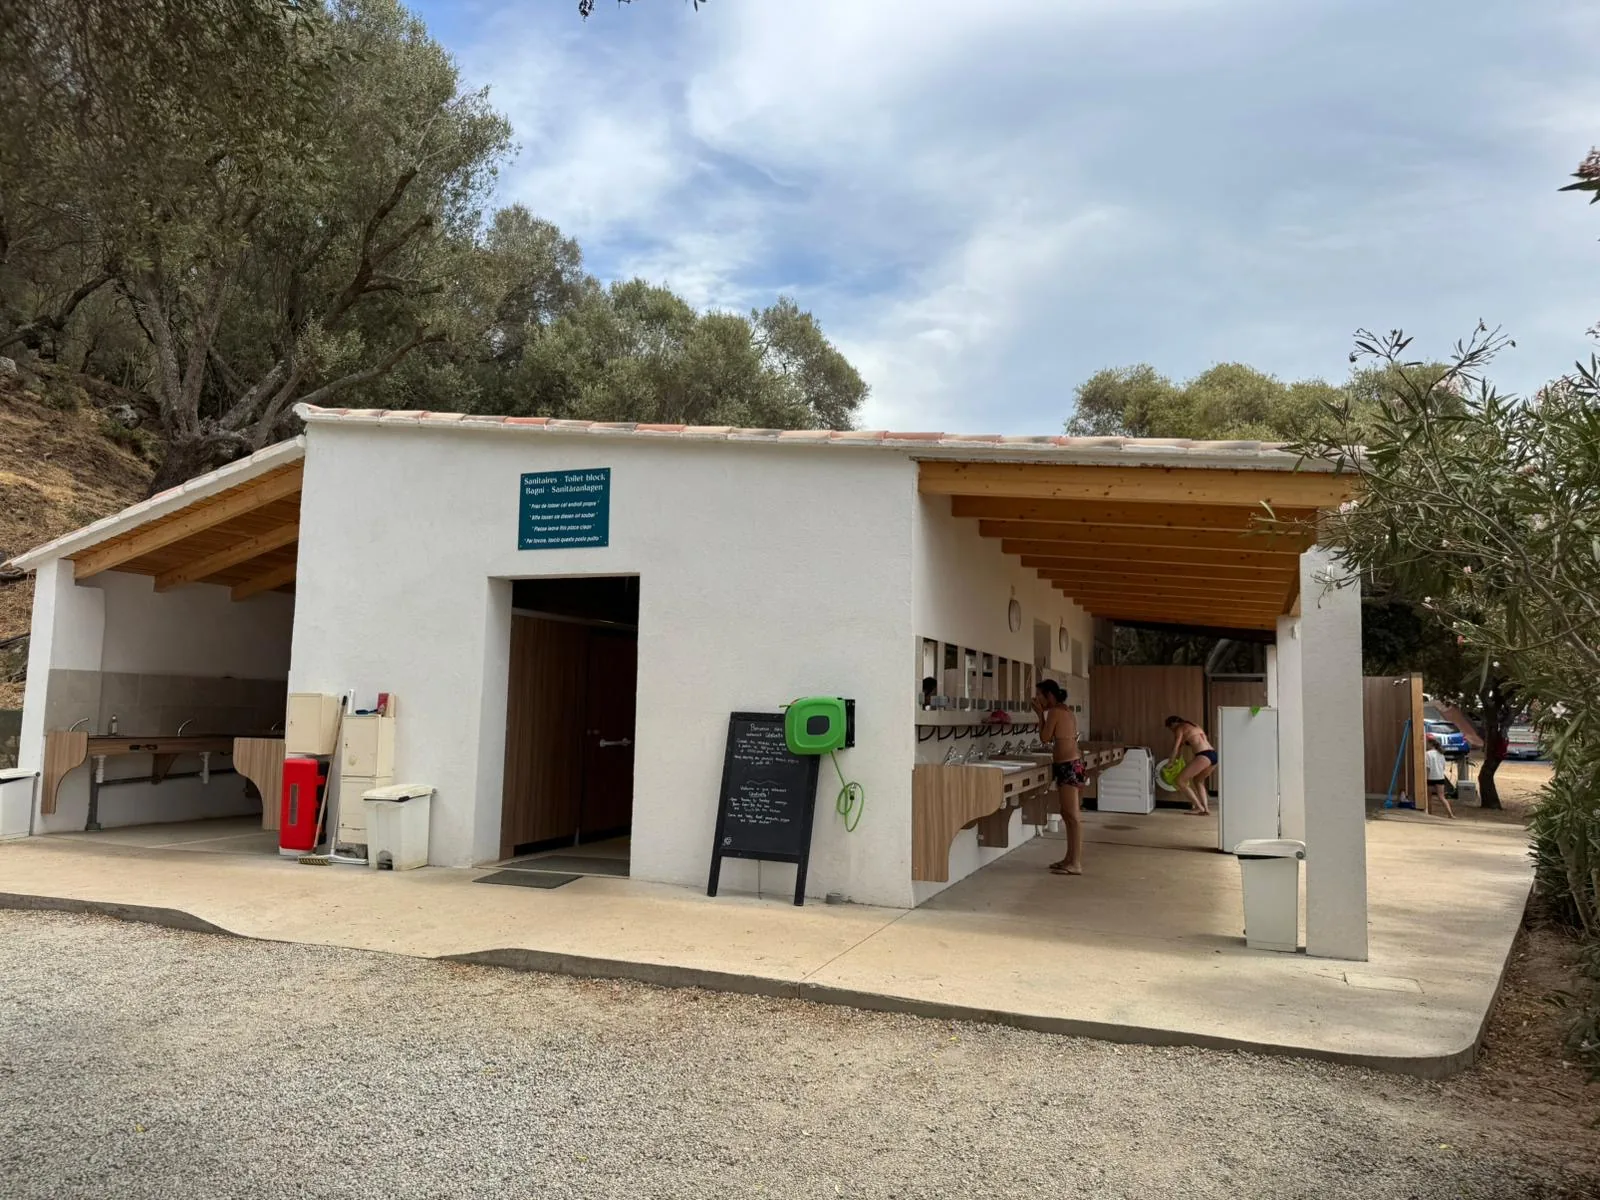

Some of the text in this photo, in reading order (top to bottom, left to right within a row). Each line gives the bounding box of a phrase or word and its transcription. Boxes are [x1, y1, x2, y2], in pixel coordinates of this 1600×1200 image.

[524, 476, 558, 485] Sanitaires
[586, 473, 606, 481] block
[526, 486, 544, 496] Bagni
